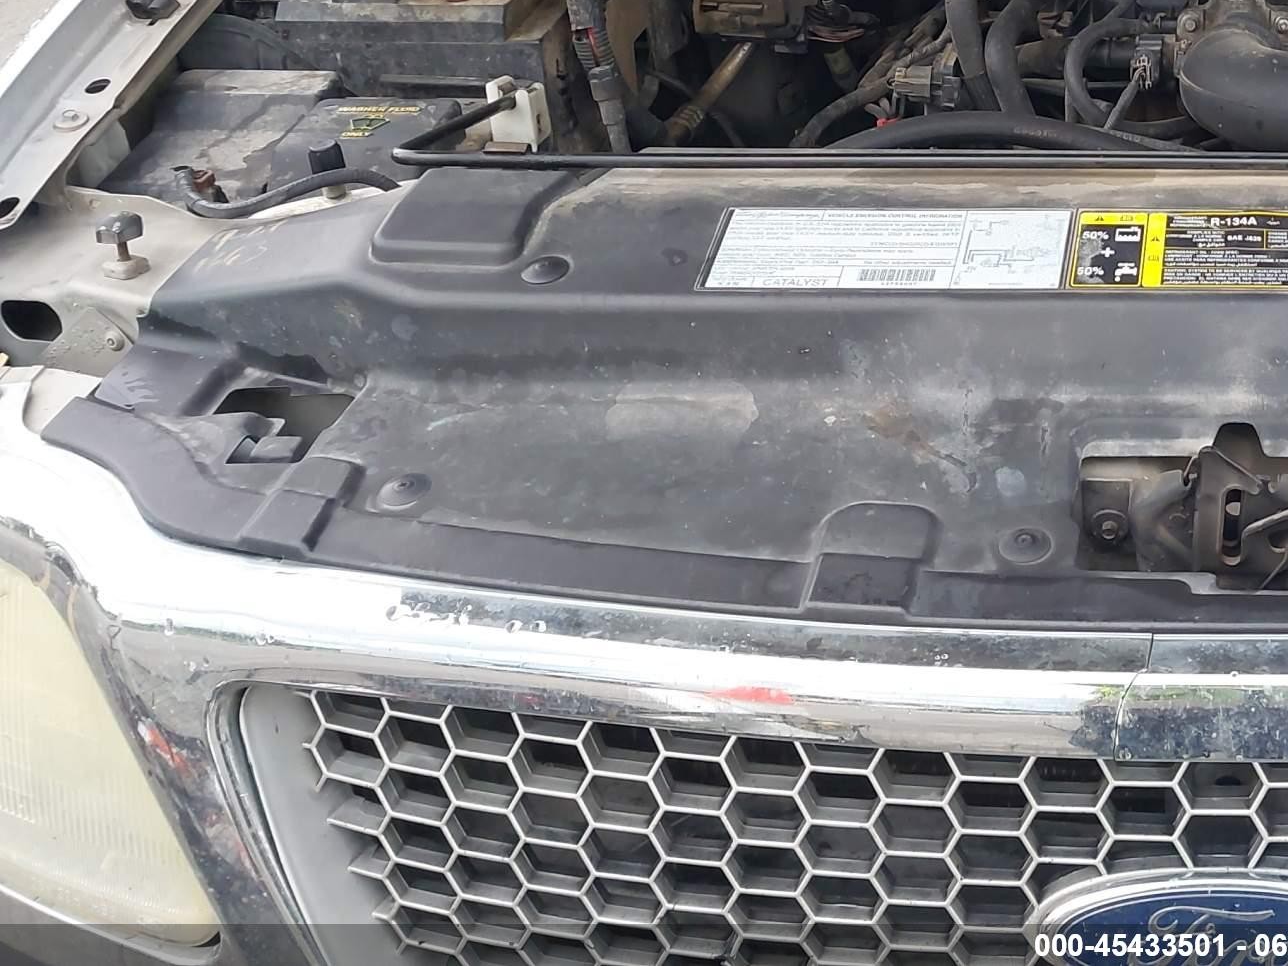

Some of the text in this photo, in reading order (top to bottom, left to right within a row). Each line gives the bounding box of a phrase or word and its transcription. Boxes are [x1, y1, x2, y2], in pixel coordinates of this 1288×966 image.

[1210, 216, 1258, 226] R-134A
[1081, 230, 1109, 240] 50%
[1077, 266, 1105, 276] 50%
[762, 278, 829, 287] CATALYST
